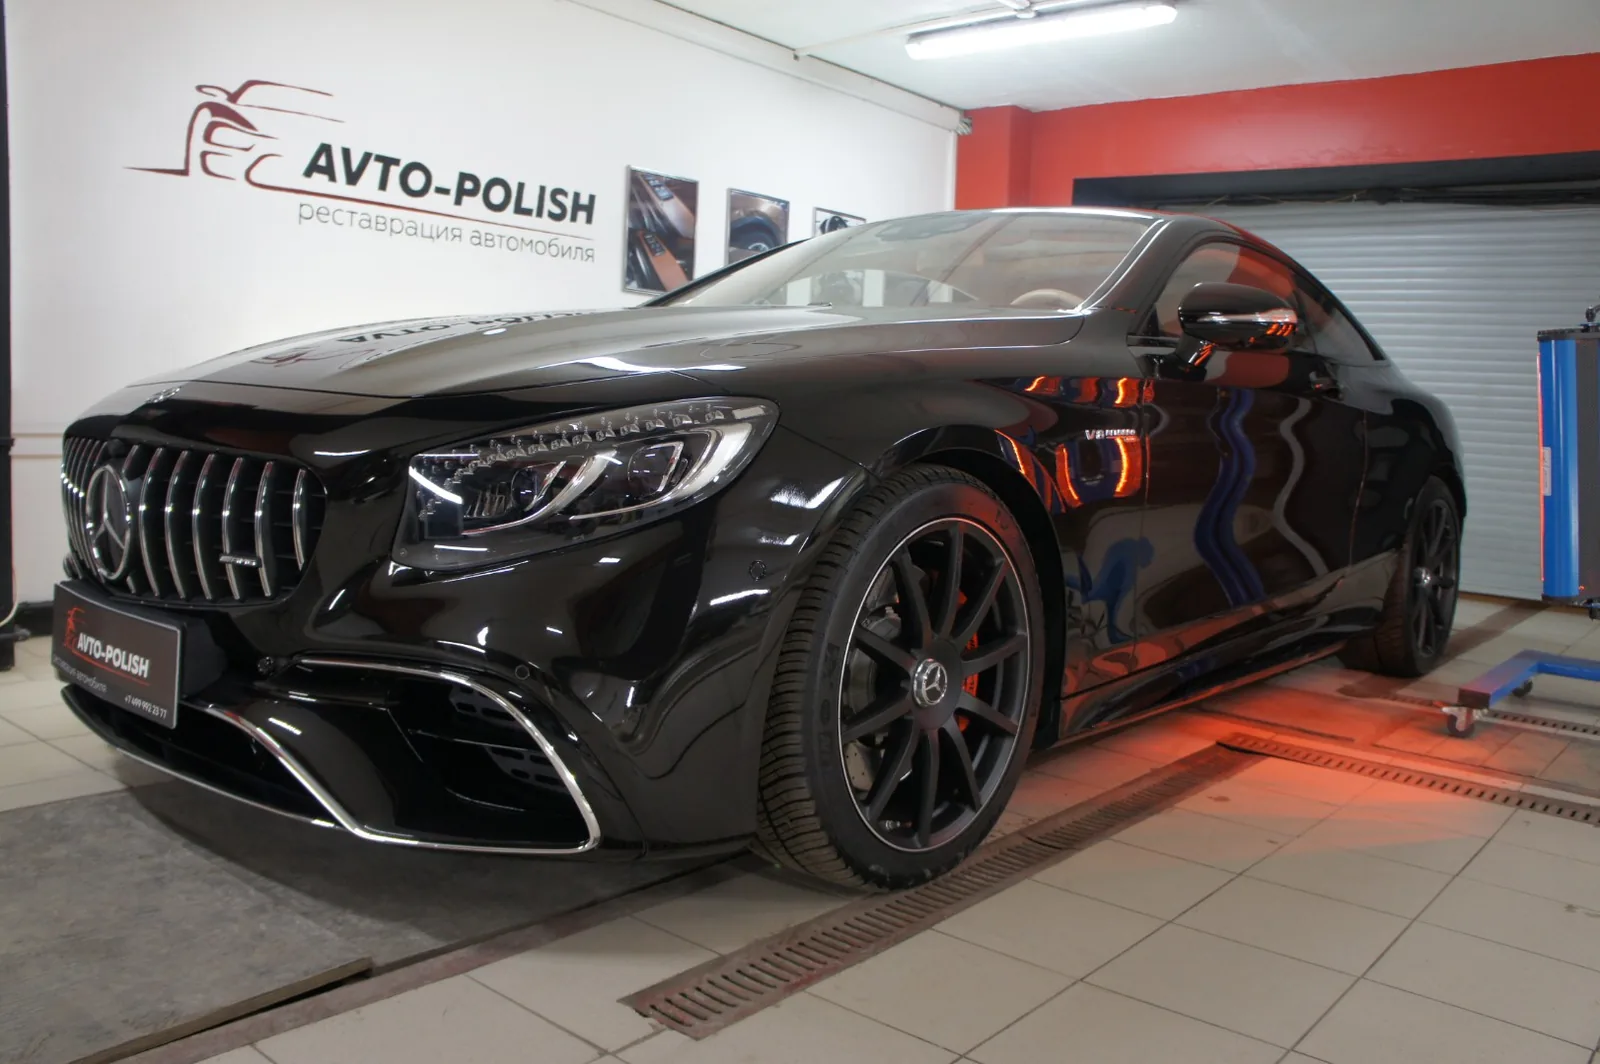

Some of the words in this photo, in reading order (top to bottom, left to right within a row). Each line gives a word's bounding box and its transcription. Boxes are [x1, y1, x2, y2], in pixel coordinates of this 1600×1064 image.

[302, 142, 596, 225] AVTO-POLISH
[298, 202, 462, 243] реставрация
[469, 229, 595, 262] автомобиля
[77, 632, 150, 678] AVTO-POLISH
